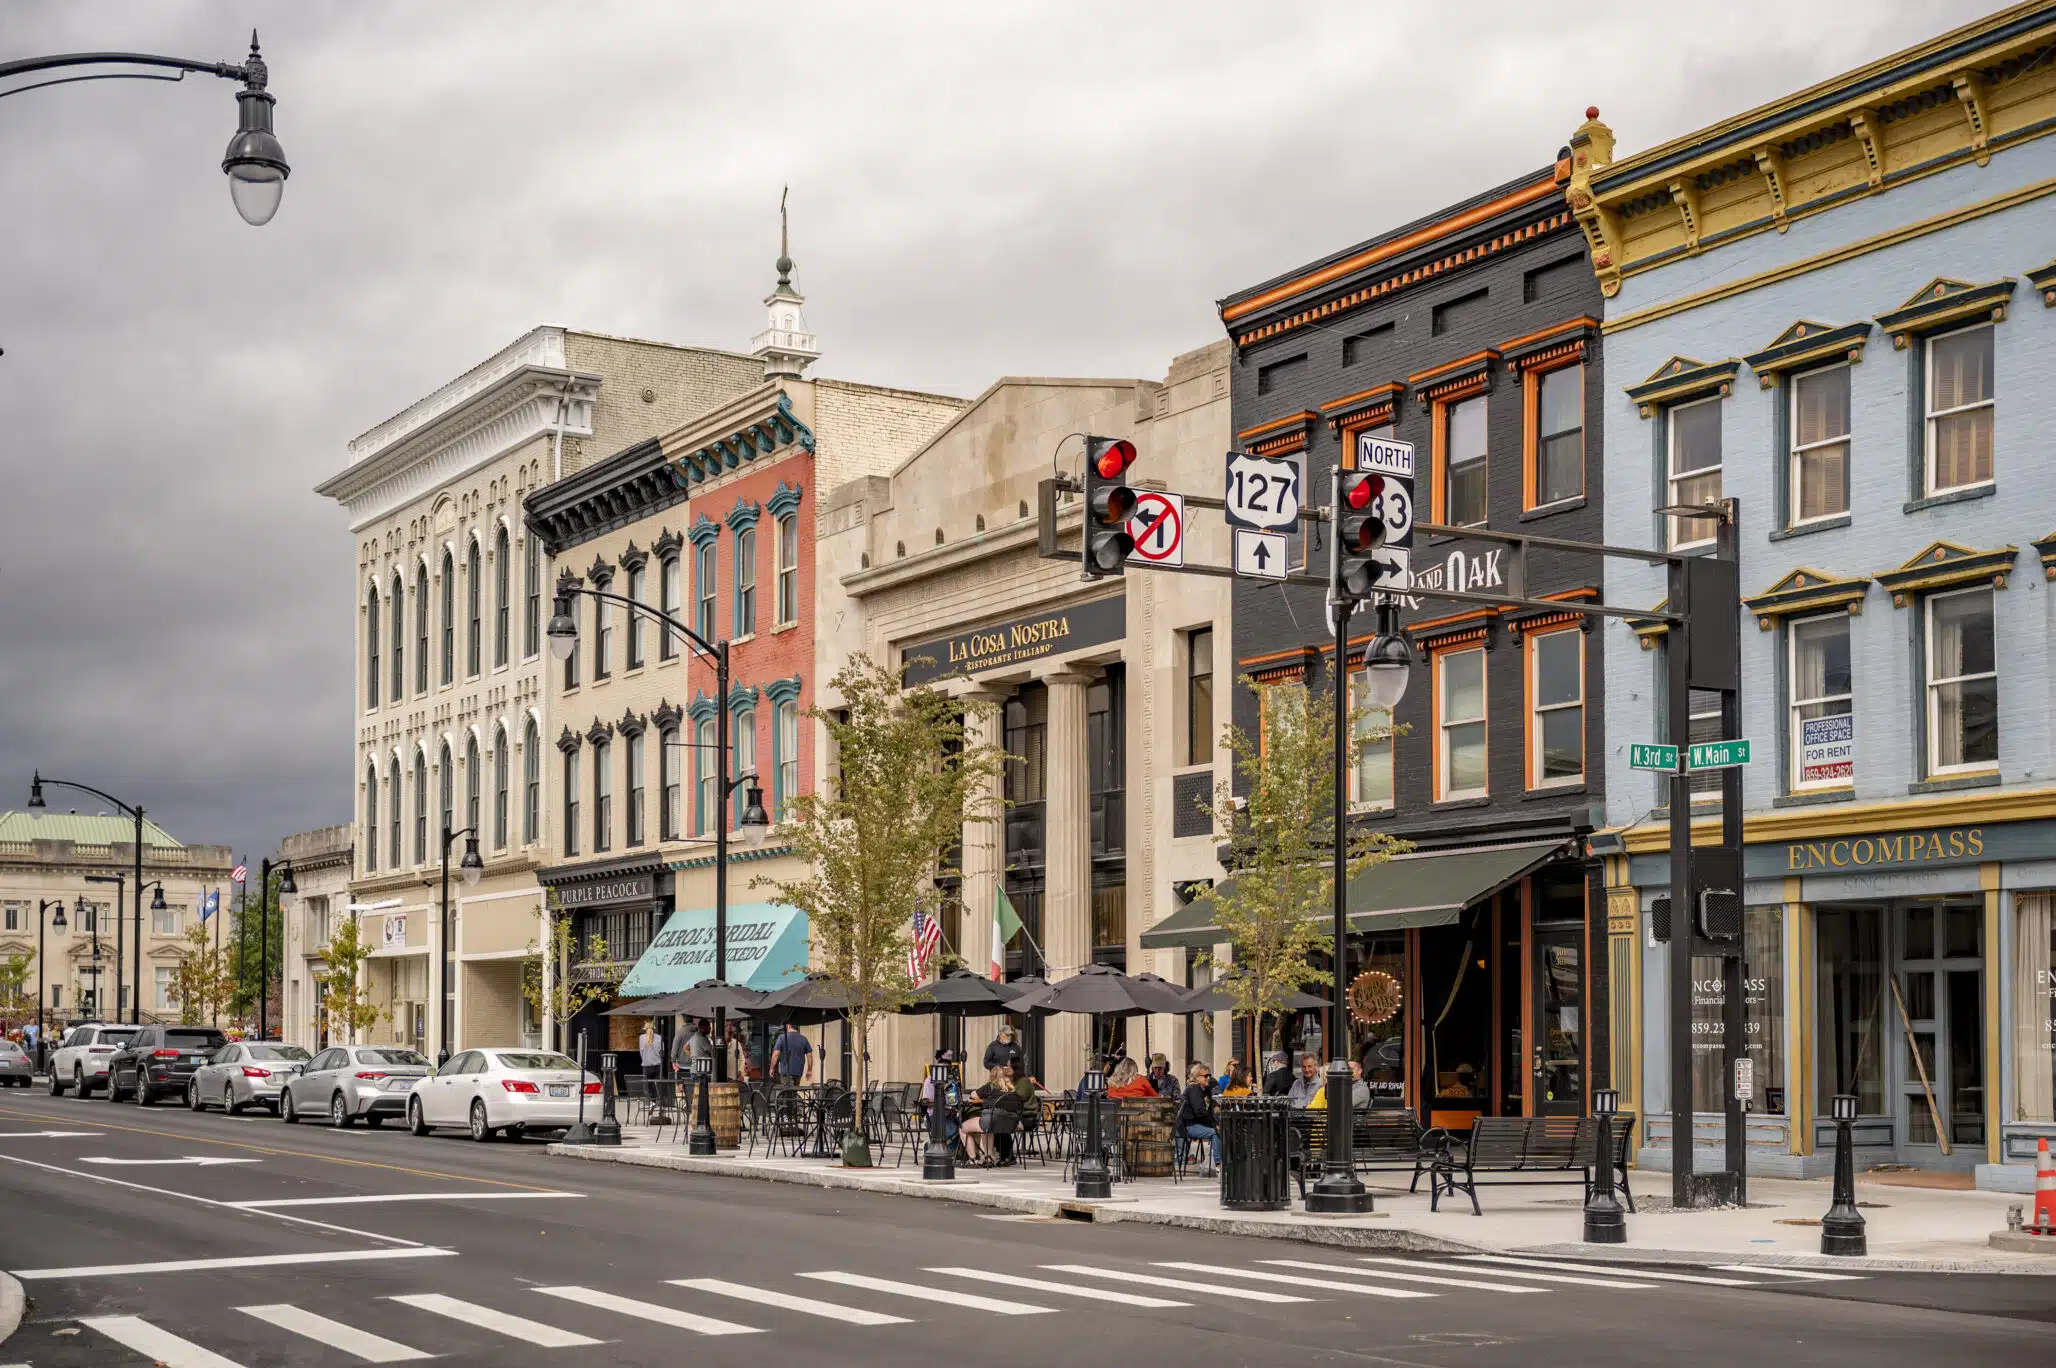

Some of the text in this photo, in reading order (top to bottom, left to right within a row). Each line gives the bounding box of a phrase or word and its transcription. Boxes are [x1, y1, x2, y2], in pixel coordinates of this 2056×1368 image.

[1363, 442, 1411, 469] NORTH
[1235, 470, 1291, 514] 127
[1447, 548, 1503, 593] OAK
[949, 616, 1070, 663] LA COSA NOSTRA
[966, 644, 1051, 671] RISTORANTE ITALIANO
[1805, 717, 1852, 734] PROFESSIONAL
[1805, 728, 1852, 745] OFFICE SPACE
[1666, 752, 1673, 762] St
[1738, 747, 1746, 758] St
[1806, 745, 1852, 760] FOR RENT
[1787, 829, 1984, 870] ENCOMPASS
[561, 881, 638, 903] PURPLE PEACOCK
[653, 921, 776, 949] CAROL'S RIDAL
[667, 945, 768, 966] PROM & UXEDO
[1694, 994, 1725, 1005] Financial
